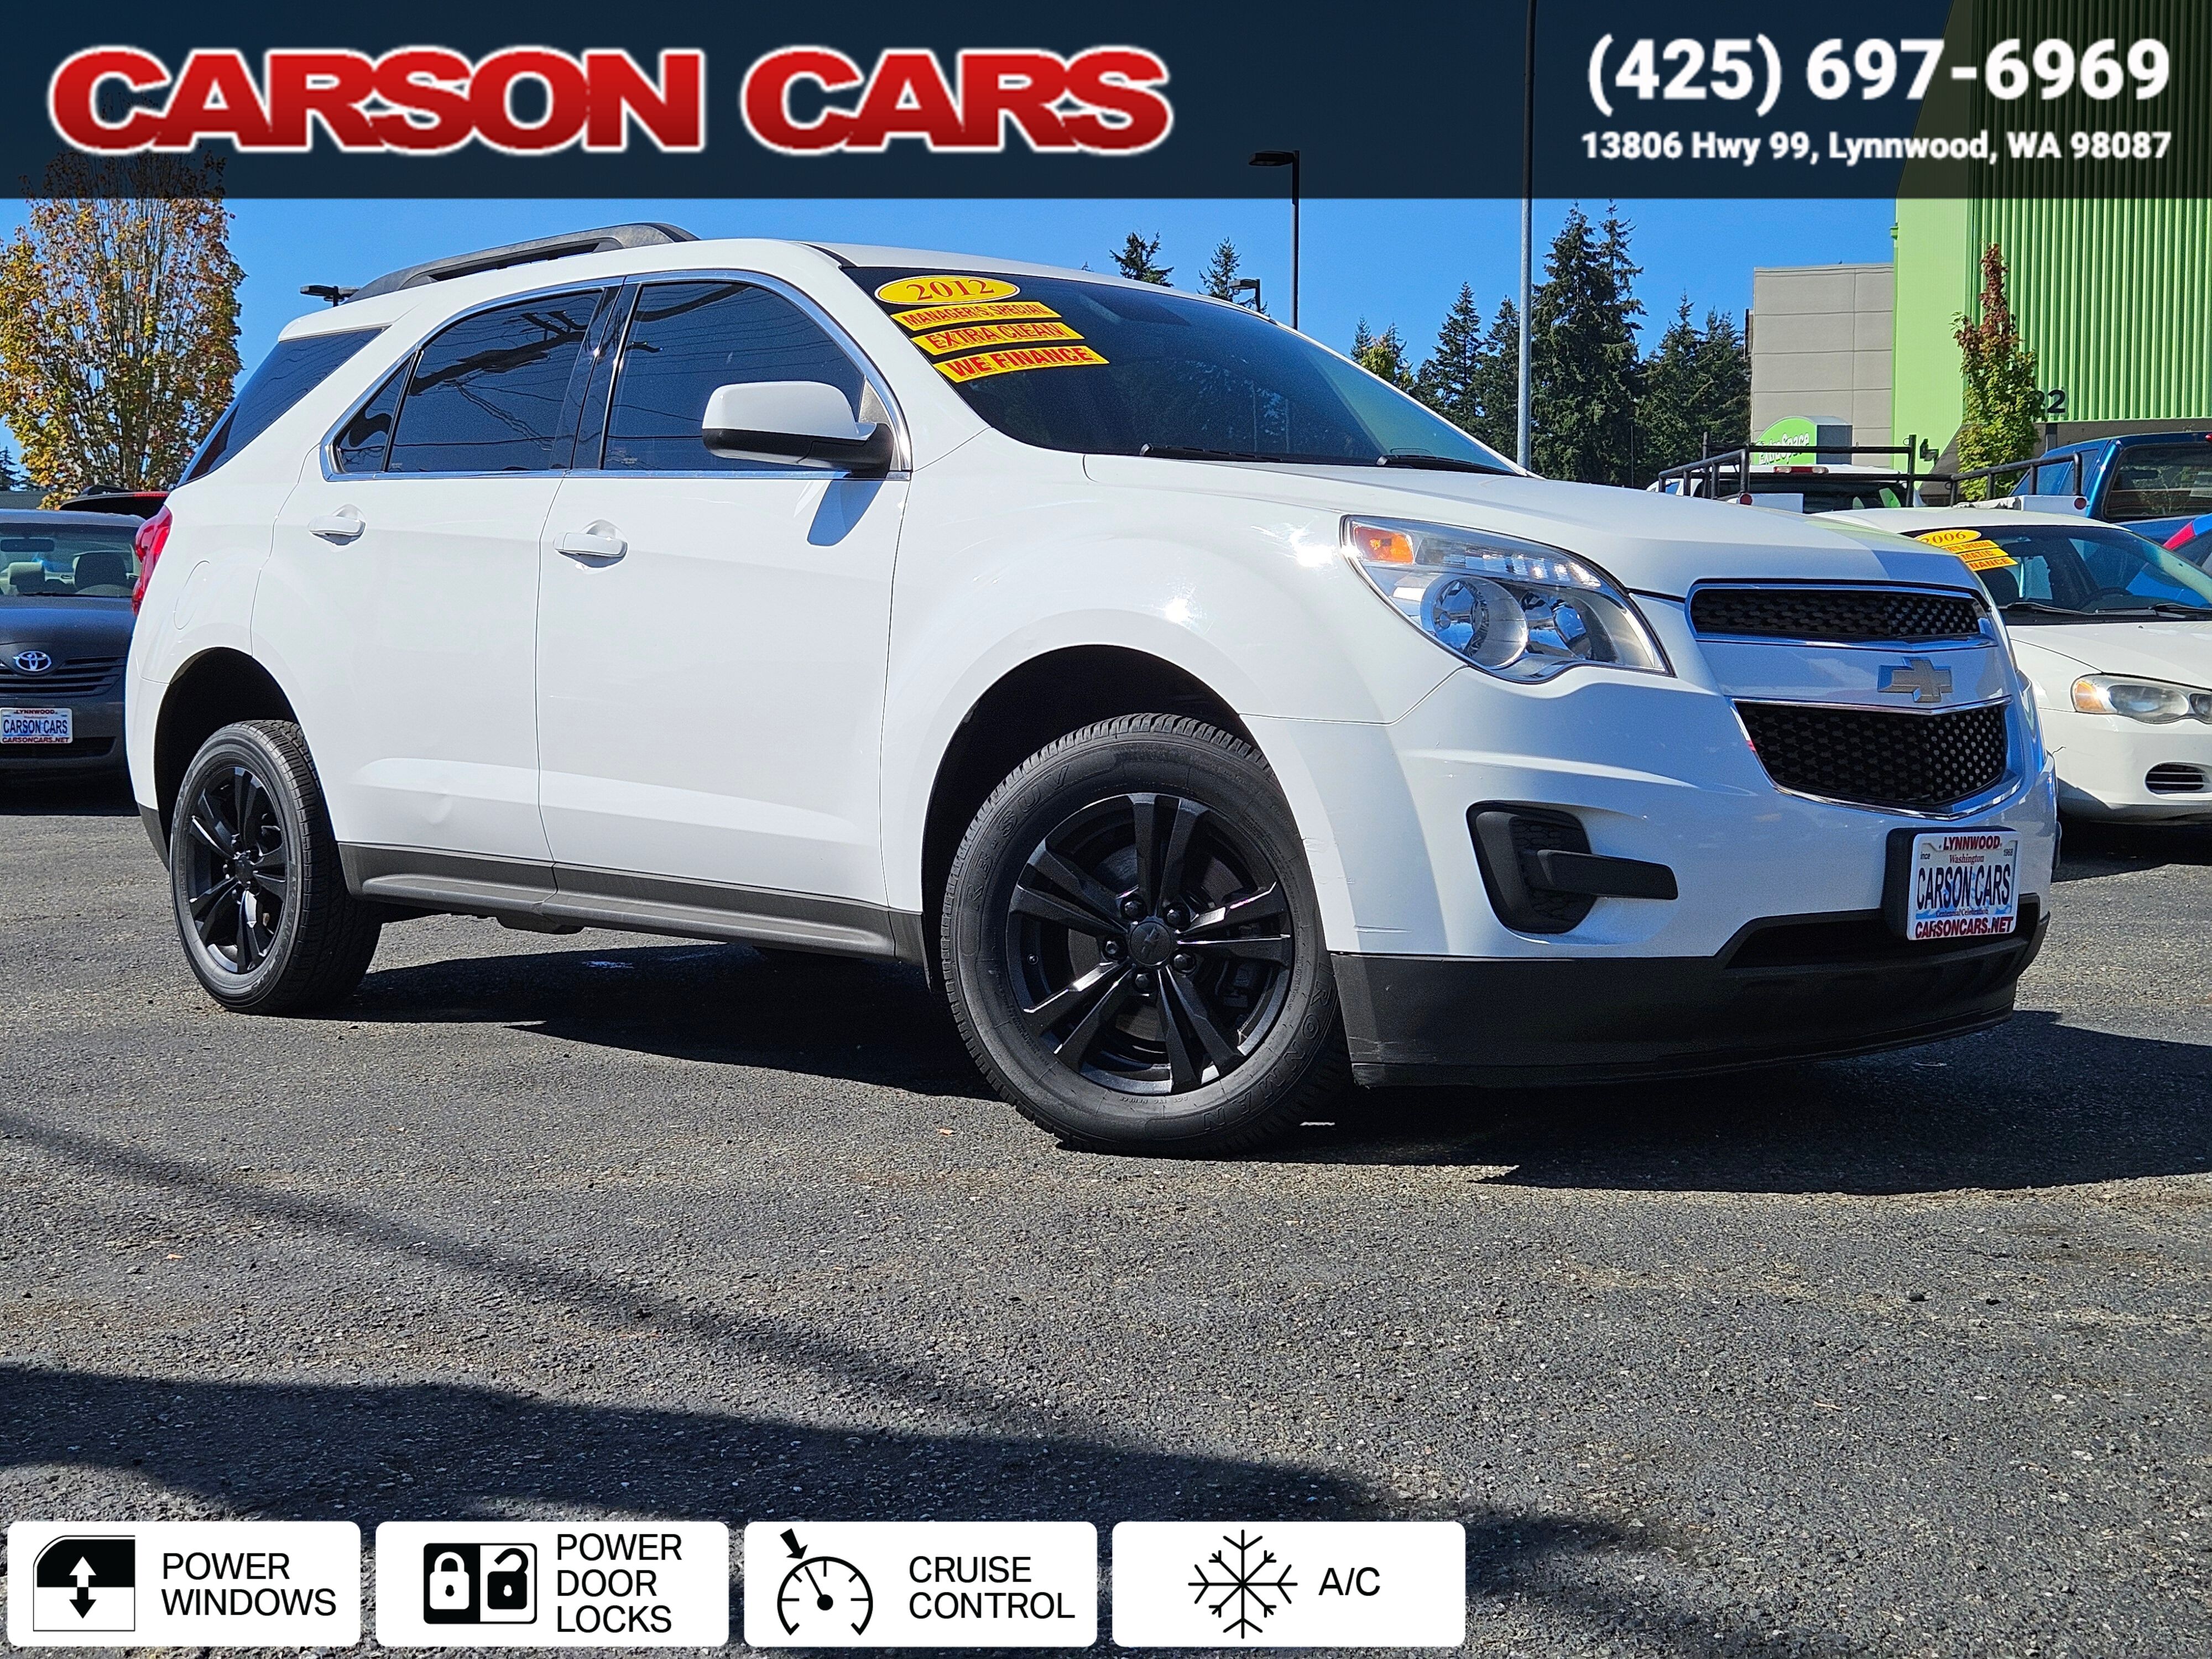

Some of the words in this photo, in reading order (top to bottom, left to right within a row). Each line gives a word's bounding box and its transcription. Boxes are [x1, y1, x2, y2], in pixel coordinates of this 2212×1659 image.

[905, 278, 995, 301] 2012
[901, 305, 990, 327] MANAGER'S
[992, 301, 1049, 316] SPECIAL
[926, 325, 999, 351] EXTRA
[1000, 323, 1068, 341] CLEAN
[946, 356, 994, 378] WE
[994, 347, 1094, 370] FINANCE
[1963, 541, 1995, 550] SPECIAL
[1969, 557, 2011, 570] NANCE
[3, 719, 41, 734] CARSON
[44, 719, 68, 734] CARS
[1943, 835, 2001, 851] LYNNWOOD
[1949, 853, 1985, 865] Washington
[1917, 865, 1973, 910] CARSON
[1975, 863, 2011, 907] CARS
[1915, 916, 2014, 939] CARSONCARS.NET
